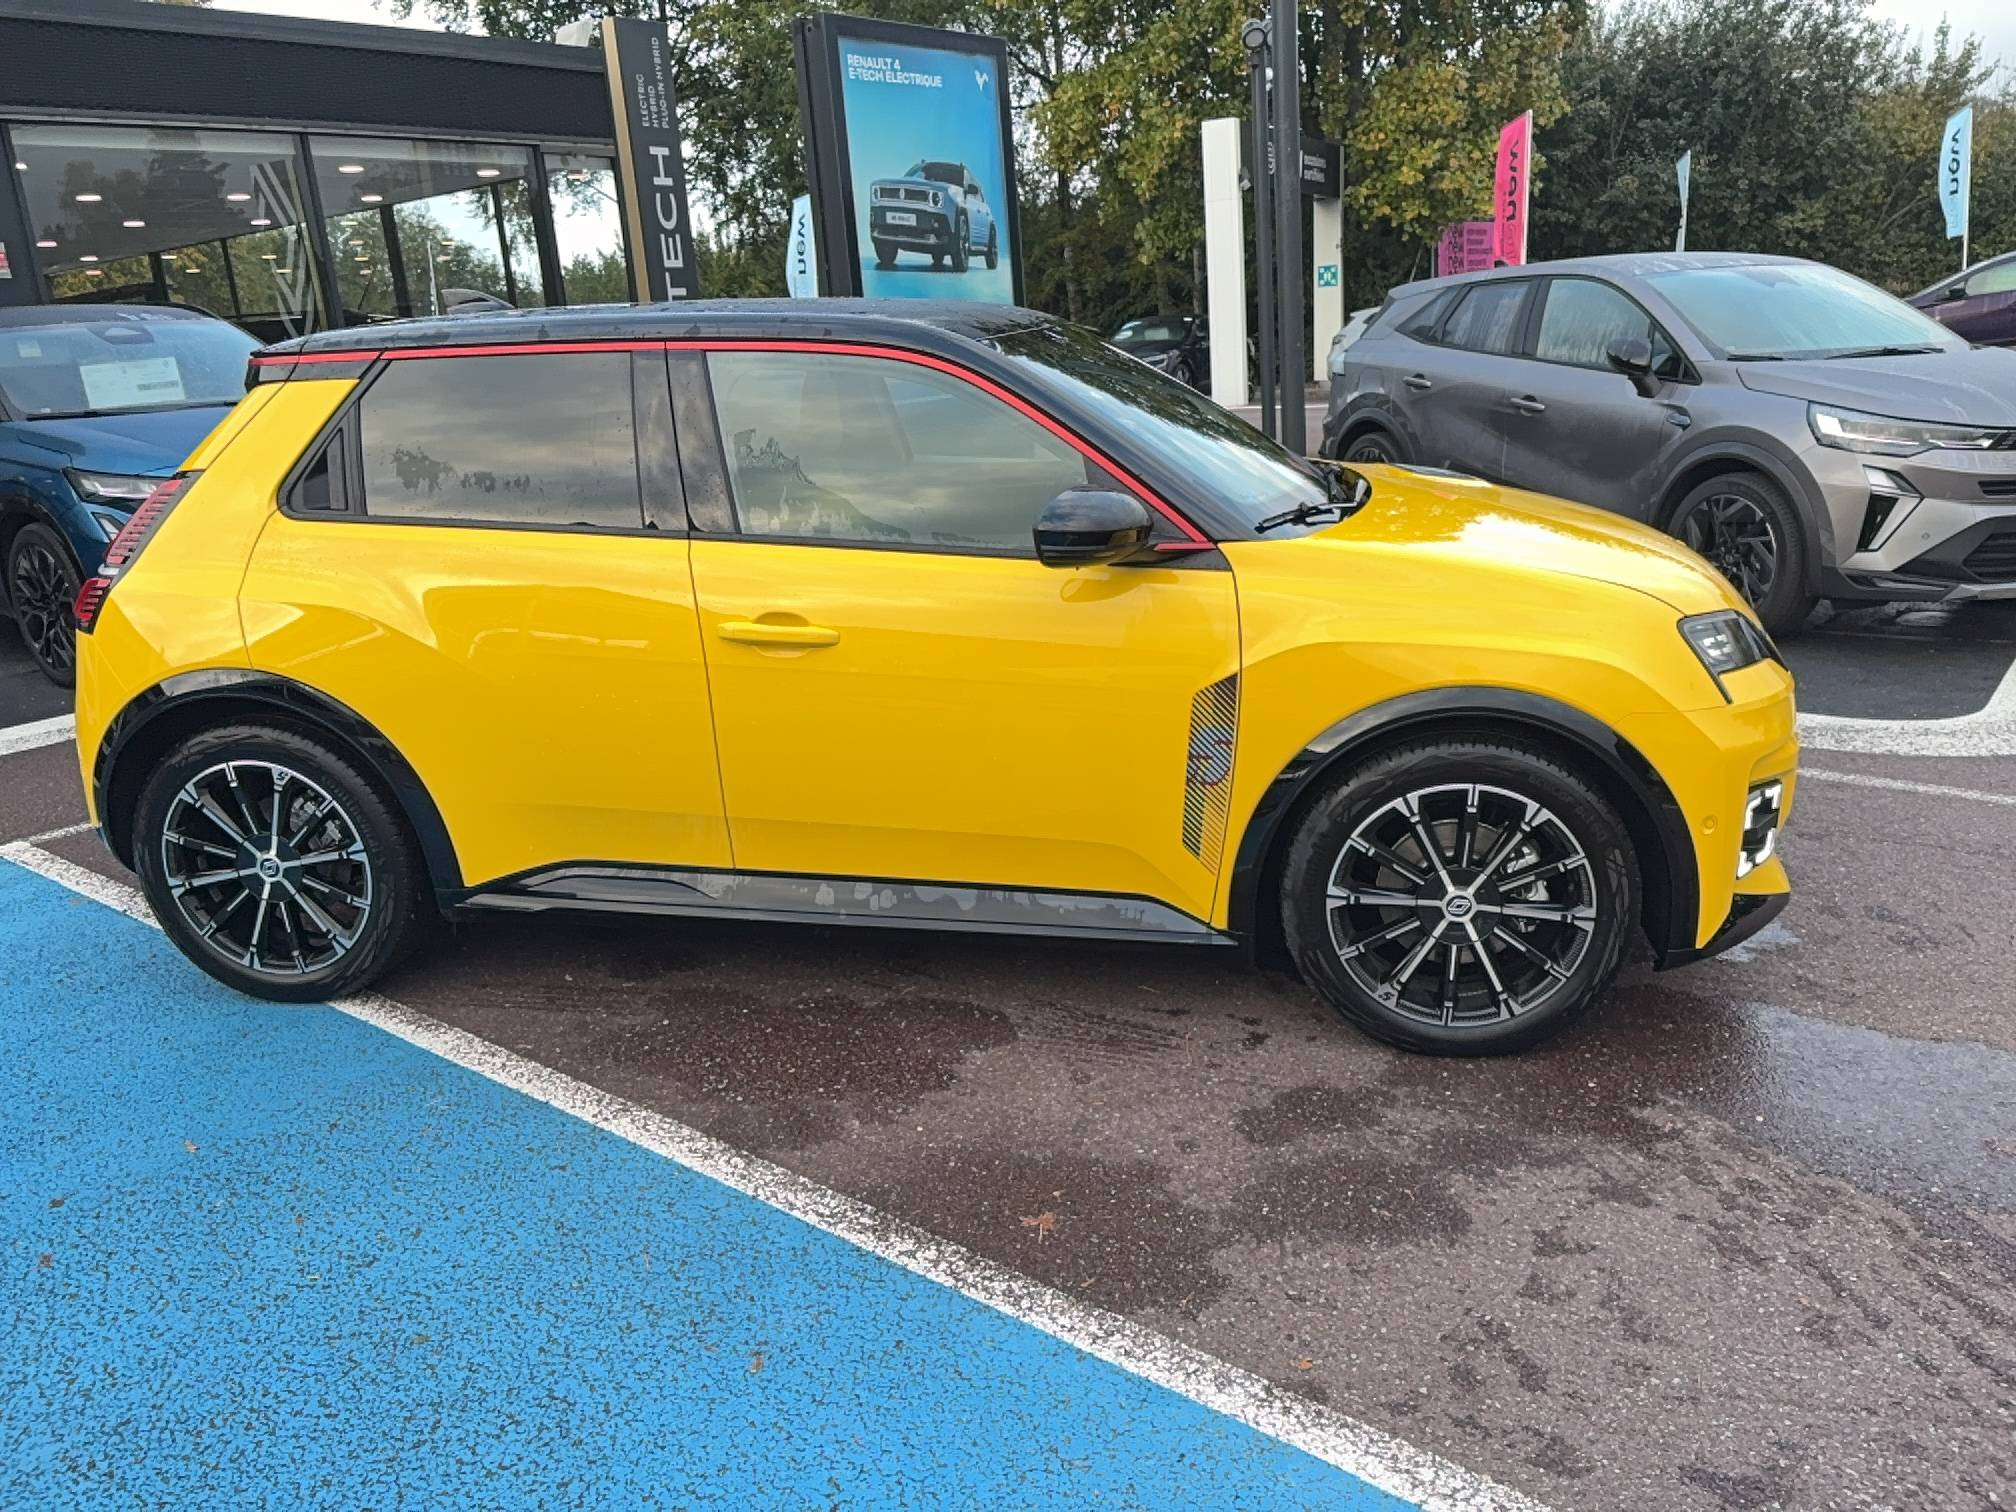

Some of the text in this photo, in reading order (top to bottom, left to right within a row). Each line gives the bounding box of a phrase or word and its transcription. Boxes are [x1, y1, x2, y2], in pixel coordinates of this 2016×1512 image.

[651, 37, 670, 129] PLUG-IN HYBRID
[847, 53, 901, 71] RENAULT 4
[848, 67, 884, 82] E-TECH
[636, 73, 650, 127] ELECTRIC
[648, 85, 660, 128] HYBRID
[648, 145, 688, 301] TECH
